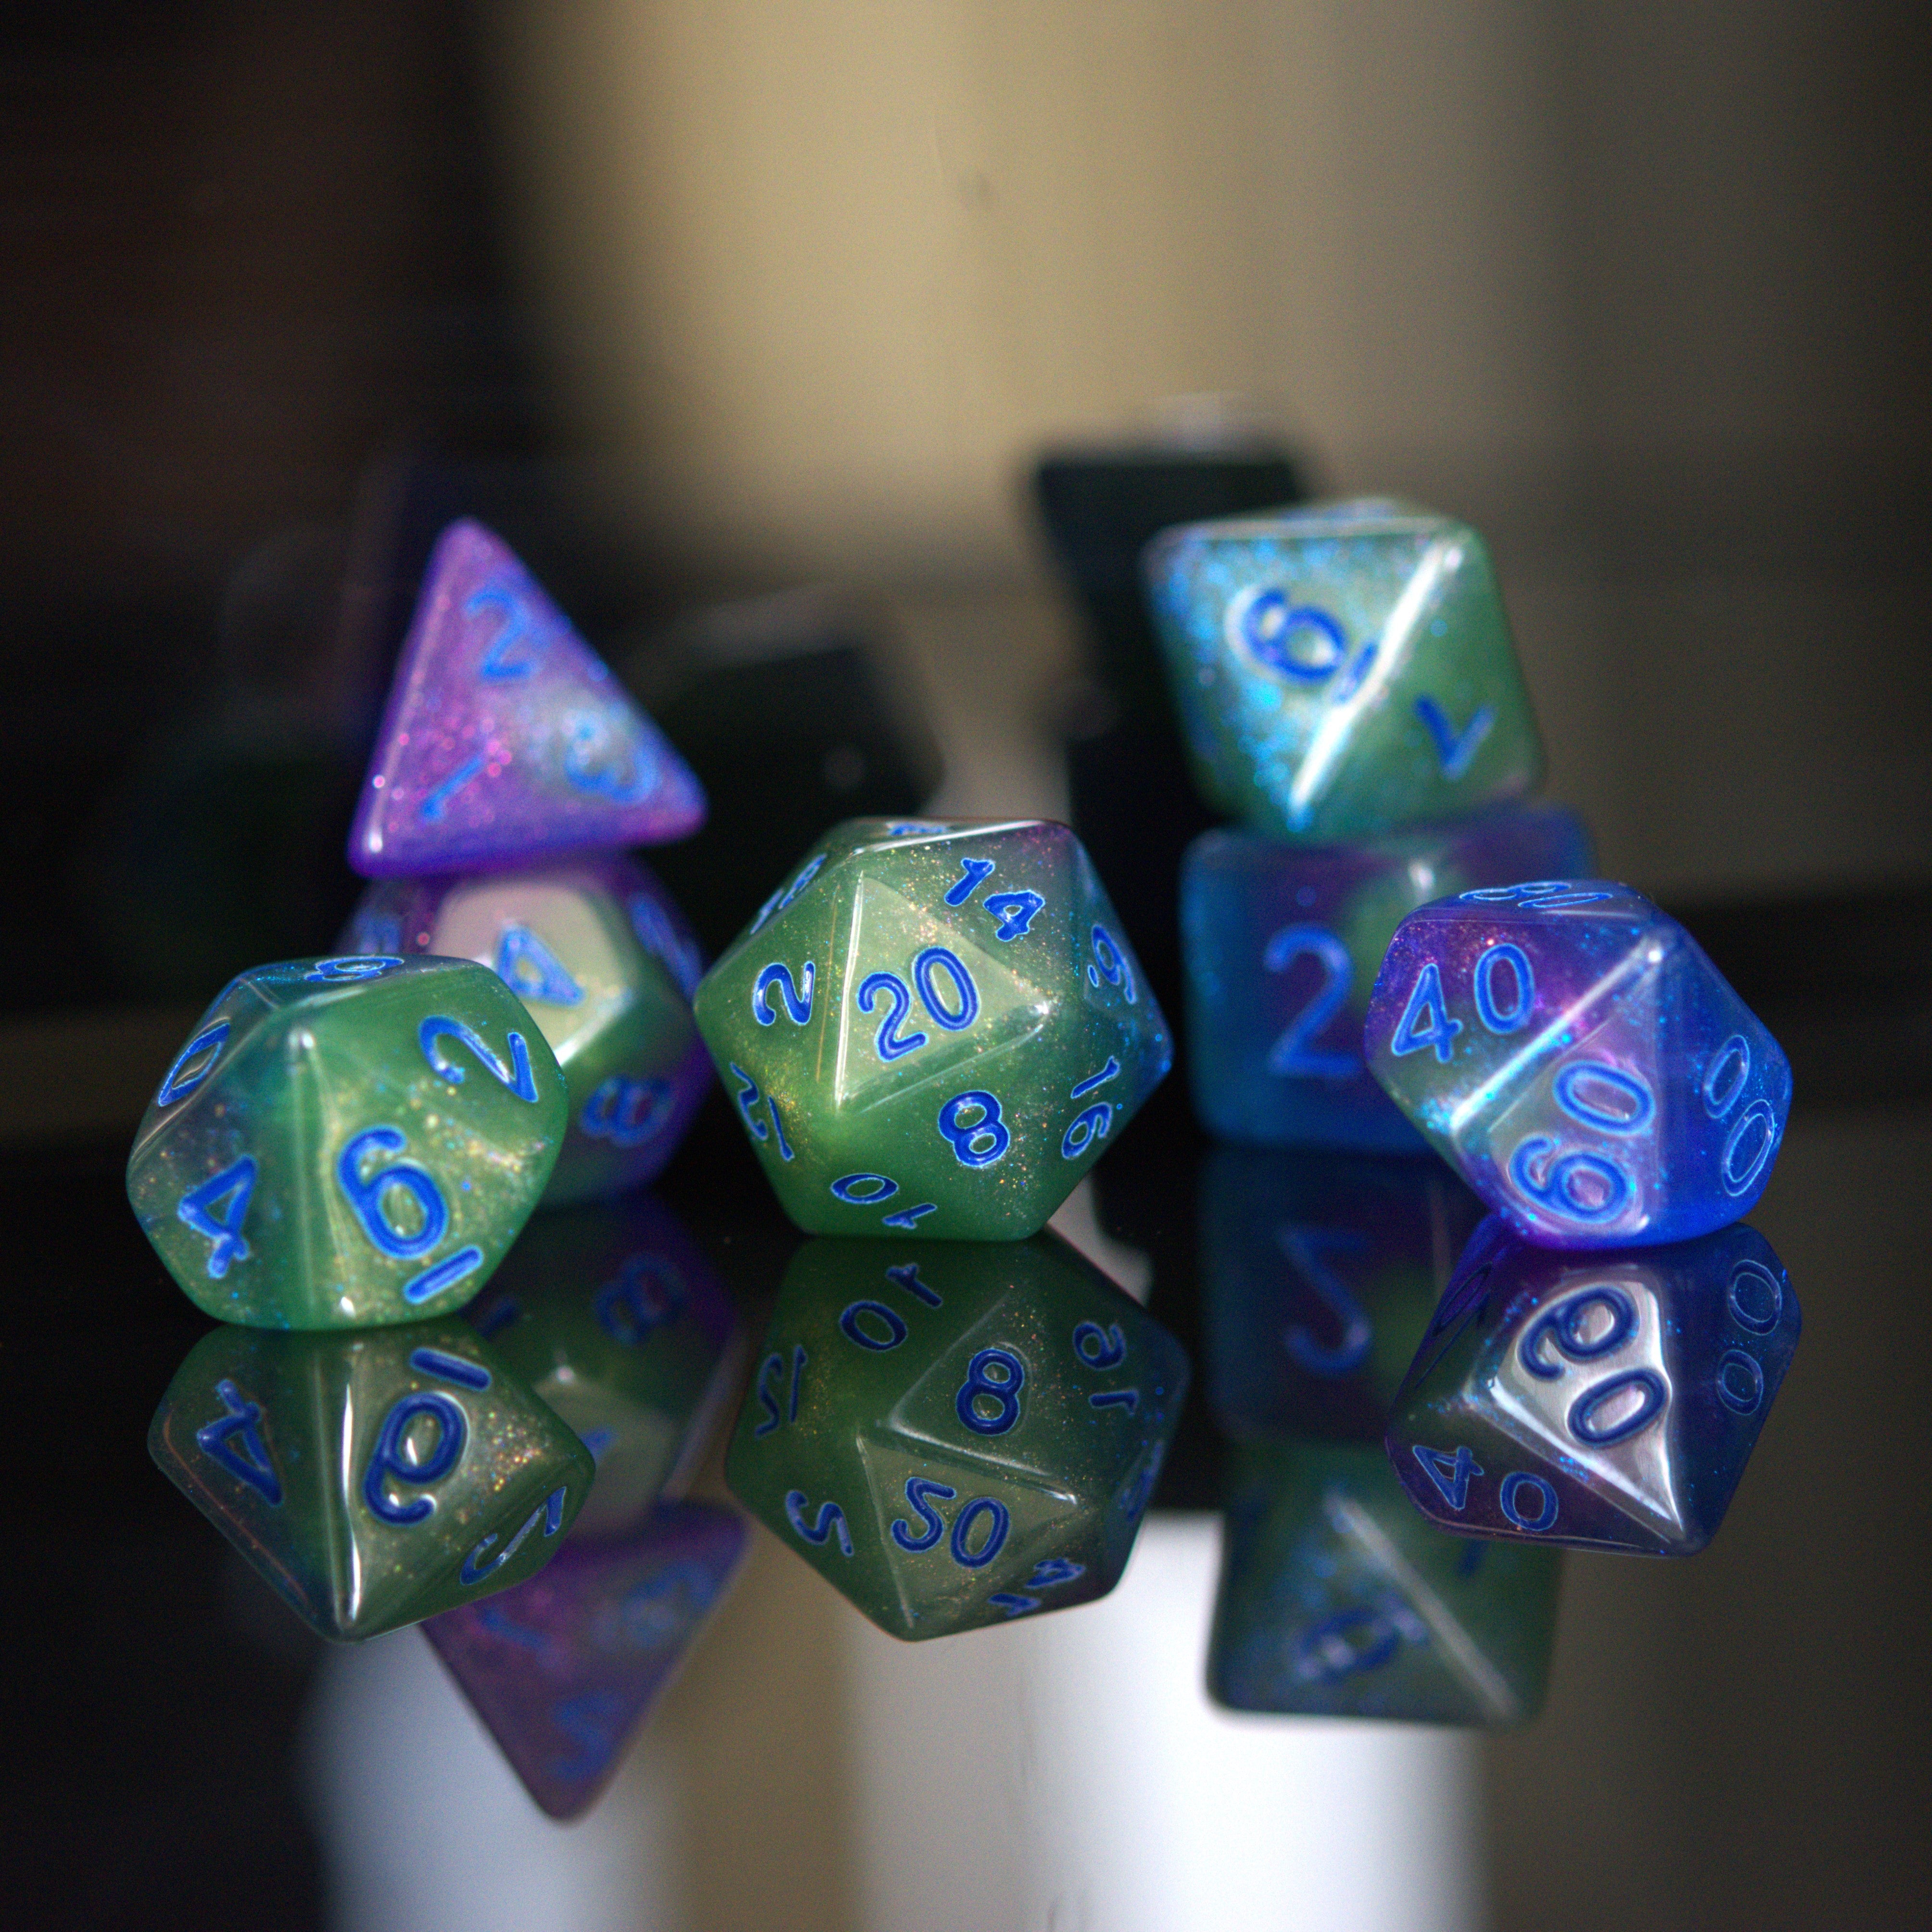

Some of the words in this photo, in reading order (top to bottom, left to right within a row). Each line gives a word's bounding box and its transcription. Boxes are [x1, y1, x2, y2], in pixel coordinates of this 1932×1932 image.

[464, 585, 536, 679] 2
[944, 858, 1044, 941] 14
[1459, 881, 1613, 908] 80
[752, 960, 815, 1025] 2
[856, 946, 980, 1062] 20
[1264, 922, 1365, 1077] 2
[1391, 943, 1534, 1063] 40
[158, 1023, 230, 1106] 0
[418, 1016, 538, 1102] 2
[938, 1090, 1010, 1168] 8
[1061, 1056, 1120, 1159] 16
[1703, 1035, 1775, 1196] 00
[178, 1156, 257, 1278] 4
[830, 1173, 937, 1229] 10
